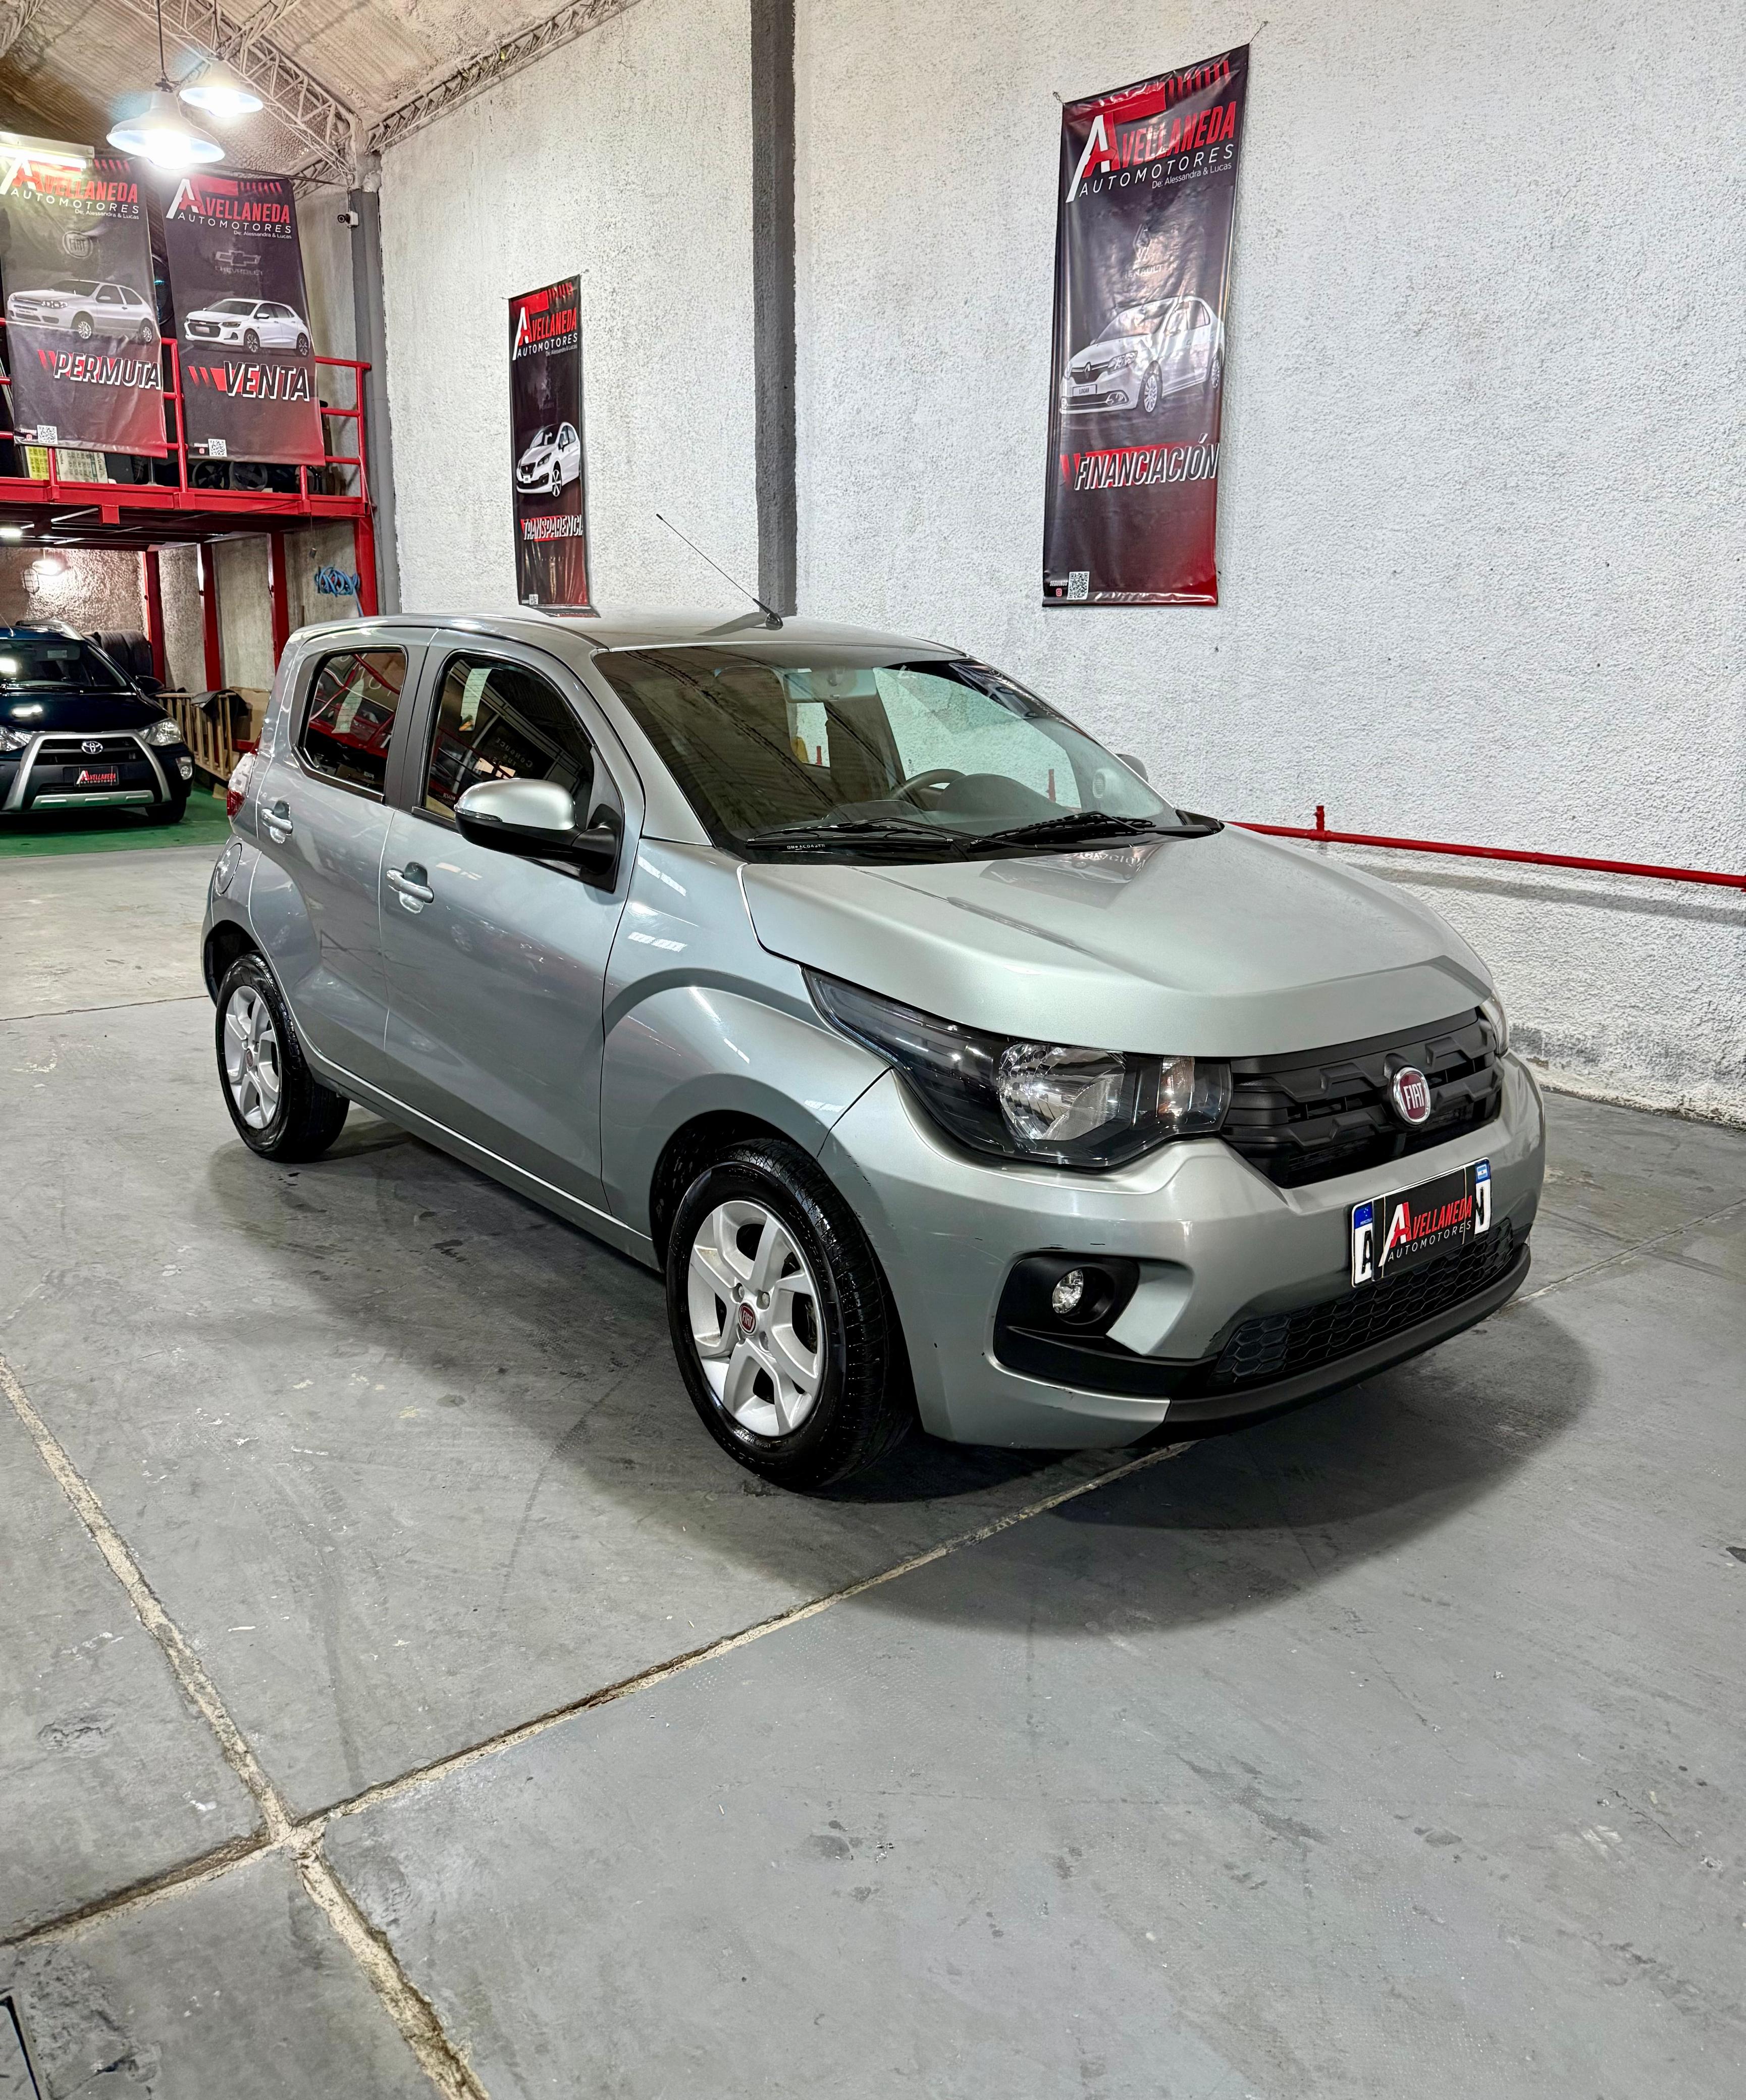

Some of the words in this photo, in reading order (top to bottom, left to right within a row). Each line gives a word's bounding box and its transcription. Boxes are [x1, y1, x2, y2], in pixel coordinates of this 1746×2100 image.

[1066, 101, 1236, 203] AVELLANEDA
[1079, 144, 1234, 197] AUTOMOTORES
[0, 157, 138, 203] AVELLANEDA
[1152, 180, 1163, 189] De:
[1165, 170, 1201, 186] Alessandra
[1203, 167, 1208, 175] &
[1210, 163, 1232, 173] Lucas
[11, 188, 139, 214] AUTOMOTORES
[166, 178, 290, 223] AVELLANEDA
[178, 212, 291, 234] AUTOMOTORES
[512, 307, 577, 360] AVELLANEDA
[517, 333, 578, 358] AUTOMOTORES
[54, 350, 162, 390] PERMUTA
[224, 361, 310, 401] VENTA
[1074, 433, 1220, 491] FINANCIACIÓN
[523, 514, 583, 540] TRANSPARENCI
[76, 770, 116, 784] AVELLANEDA
[1403, 1082, 1424, 1110] FIAT
[1378, 1195, 1472, 1267] AVELLANEDA
[1388, 1220, 1472, 1262] AUTOMOTORES
[742, 1309, 753, 1328] FIAT
